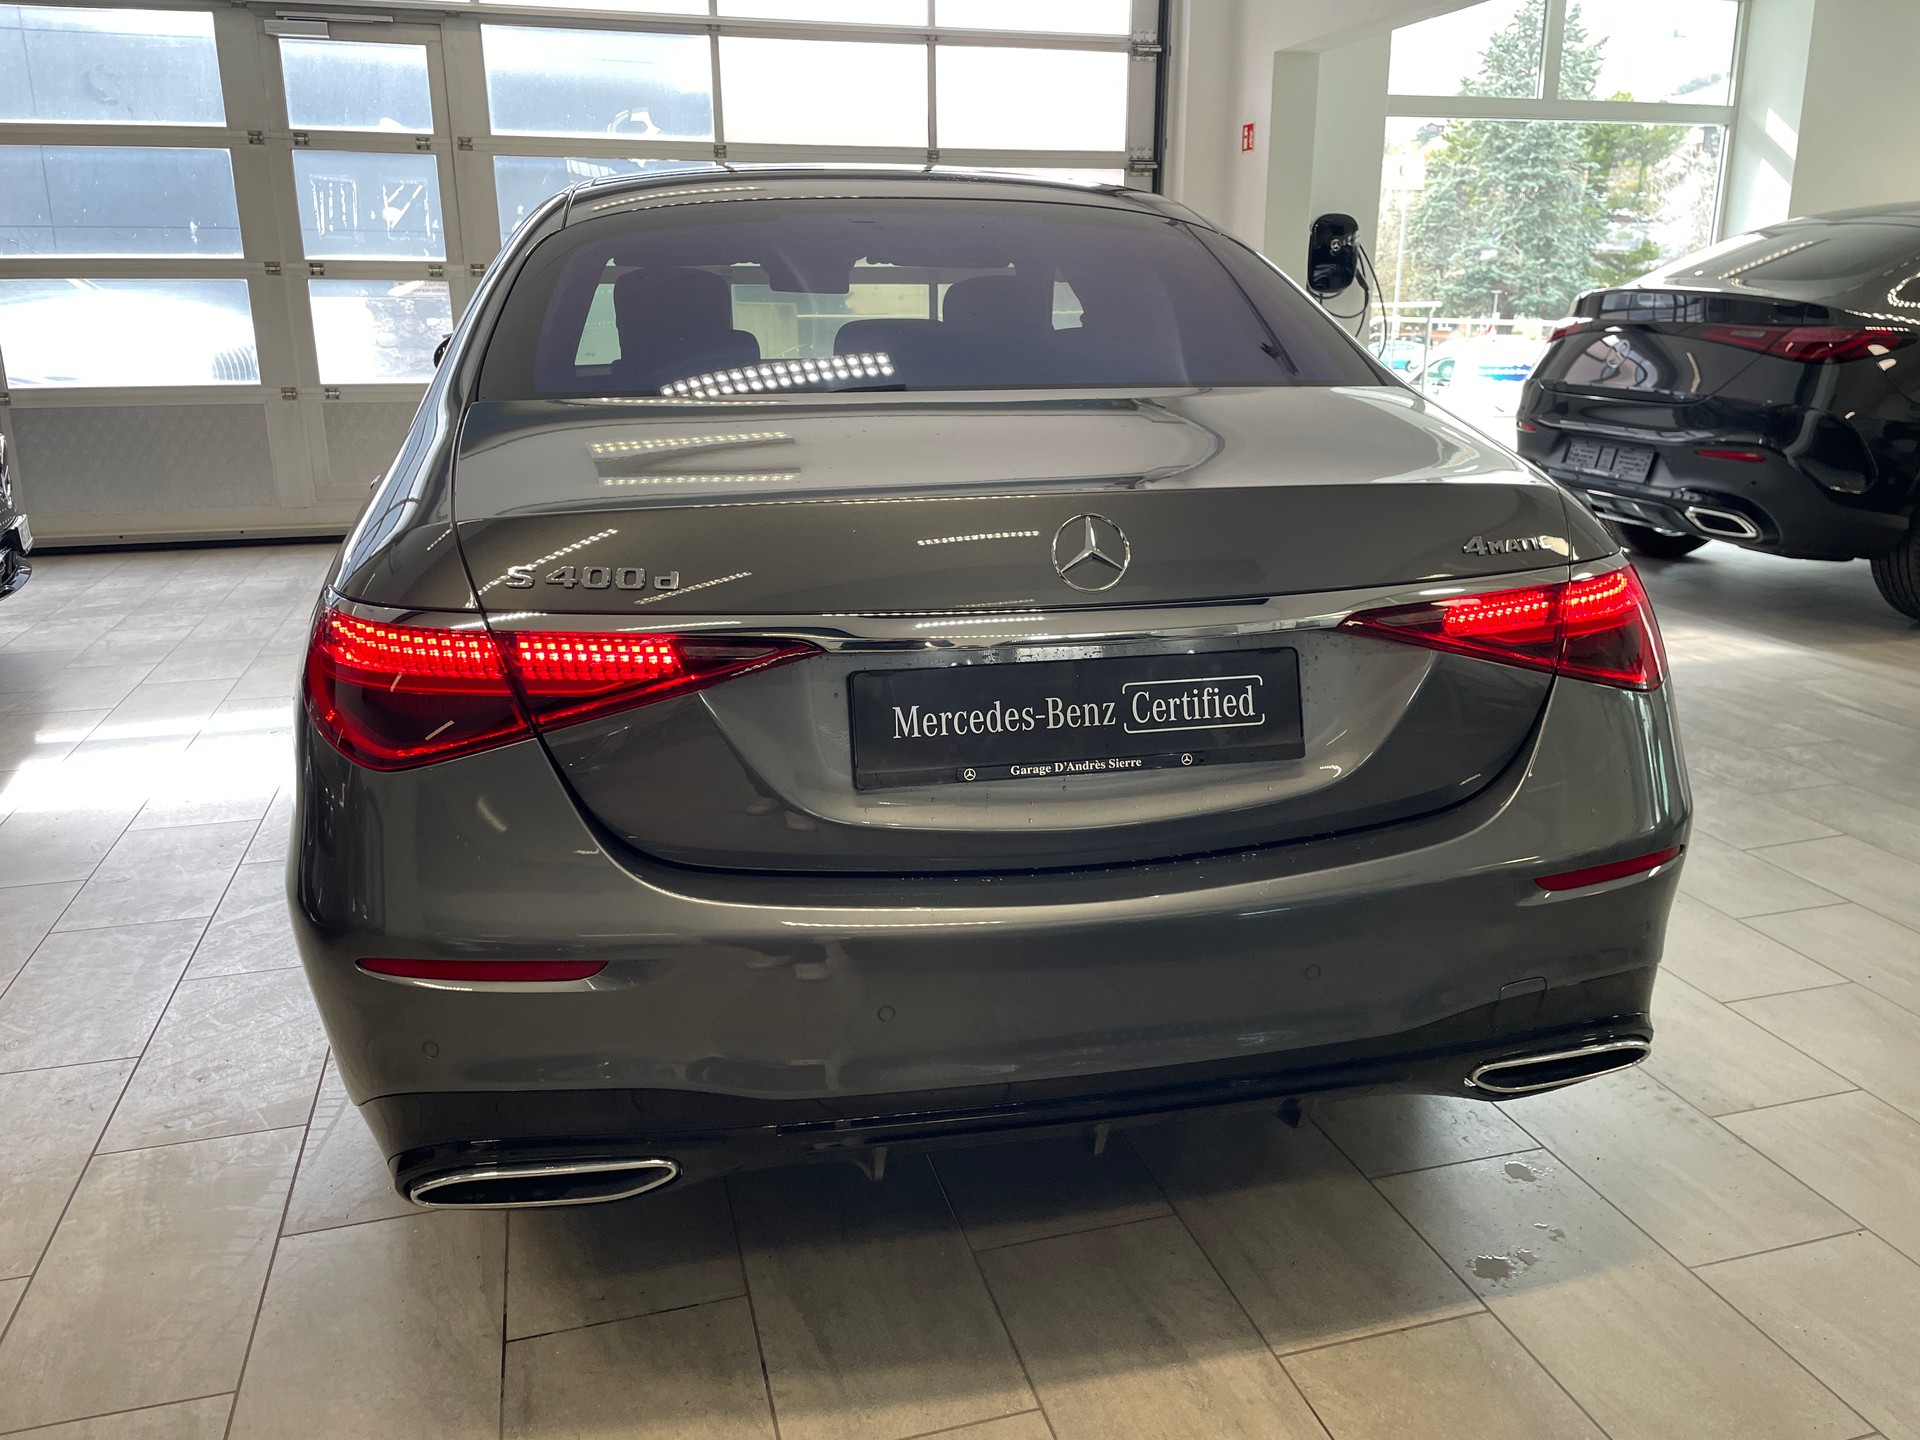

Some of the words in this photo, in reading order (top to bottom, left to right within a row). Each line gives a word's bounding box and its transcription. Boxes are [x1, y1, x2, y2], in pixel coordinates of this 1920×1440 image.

[1462, 534, 1552, 555] 4MATIC
[505, 565, 536, 589] S
[892, 697, 1116, 739] Mercedes-Benz
[1131, 684, 1256, 724] Certified
[1010, 764, 1052, 776] Garage
[1054, 760, 1106, 773] D'Andrès
[1109, 757, 1142, 769] Sierre
